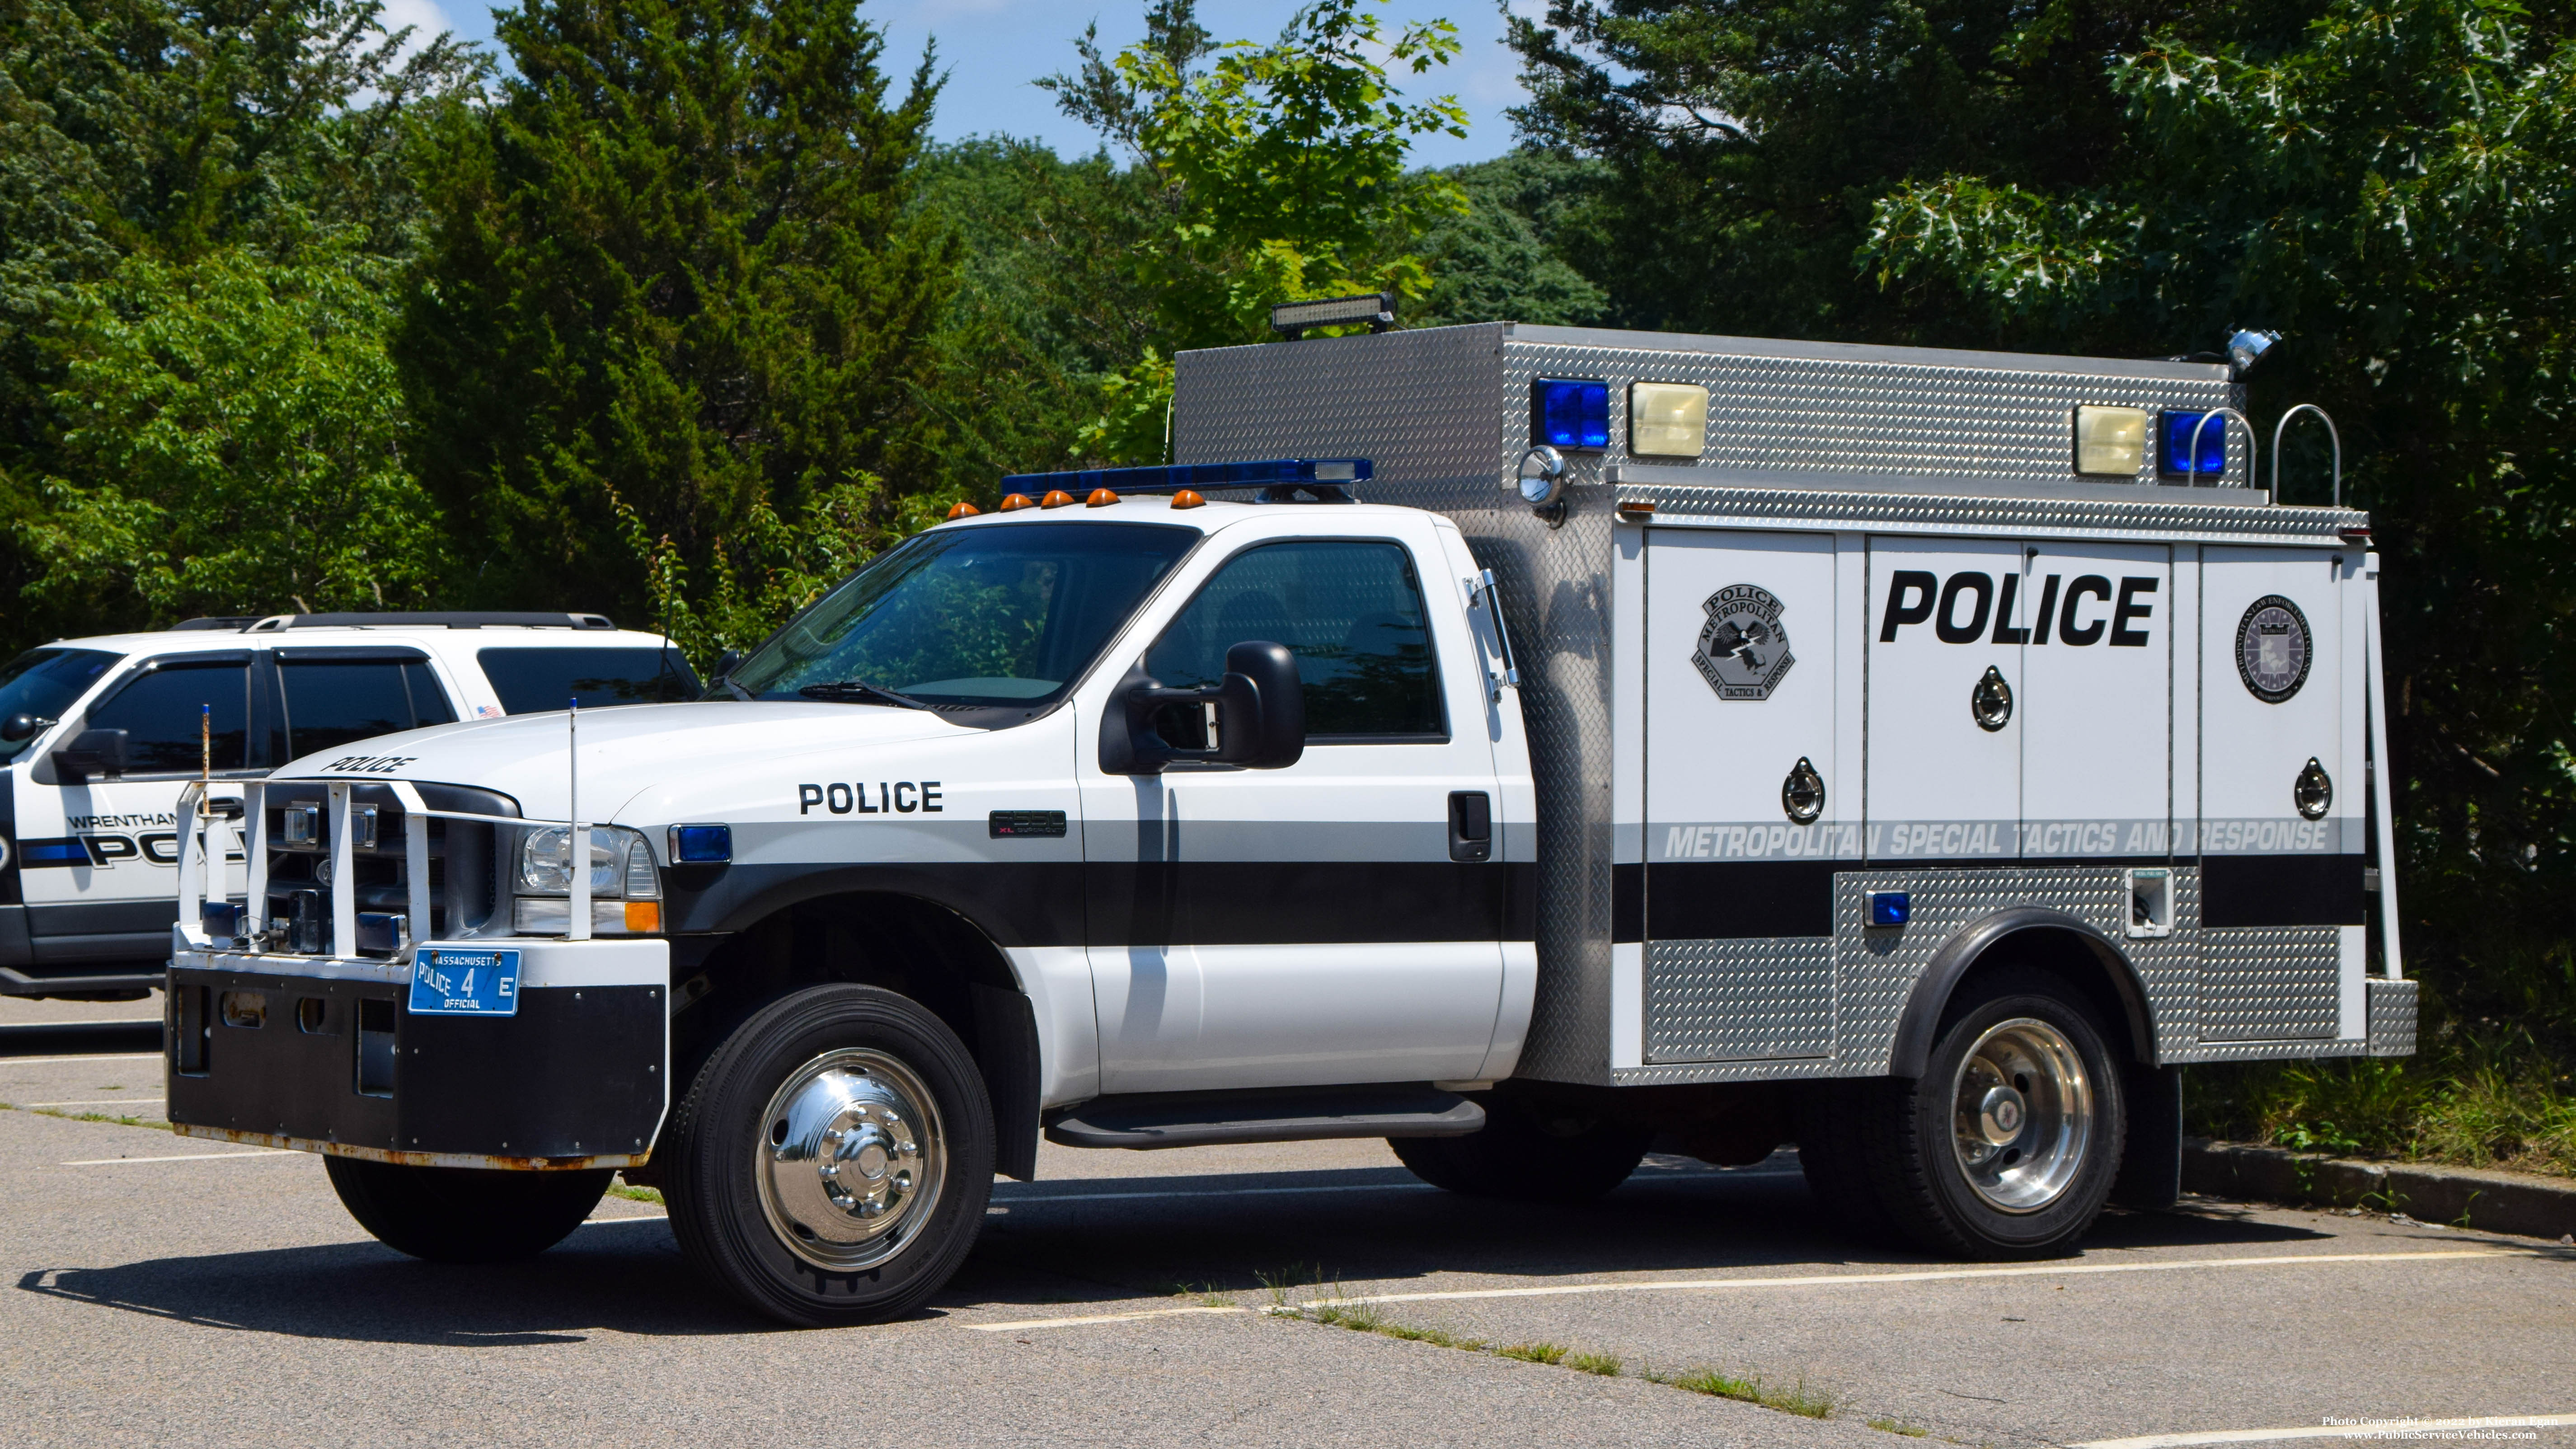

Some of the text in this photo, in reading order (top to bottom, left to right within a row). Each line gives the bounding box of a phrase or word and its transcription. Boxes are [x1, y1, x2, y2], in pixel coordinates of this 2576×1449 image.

[1708, 587, 1778, 612] POLICE
[1879, 569, 2160, 647] POLICE
[1702, 601, 1785, 644] METROPOLITAN
[2237, 597, 2312, 684] METROPOLITAN LAW ENFORCEMENT COUNCIL
[1696, 655, 1792, 697] SPECIAL TACTICS & RESPONSE
[319, 756, 419, 773] POLICE
[798, 781, 943, 815] POLICE
[1665, 821, 2328, 858] METROPOLITAN SPECIAL TACTICS AND RESPONSE
[418, 961, 514, 998] POLICE 4 E
[444, 999, 480, 1009] OFFICIAL
